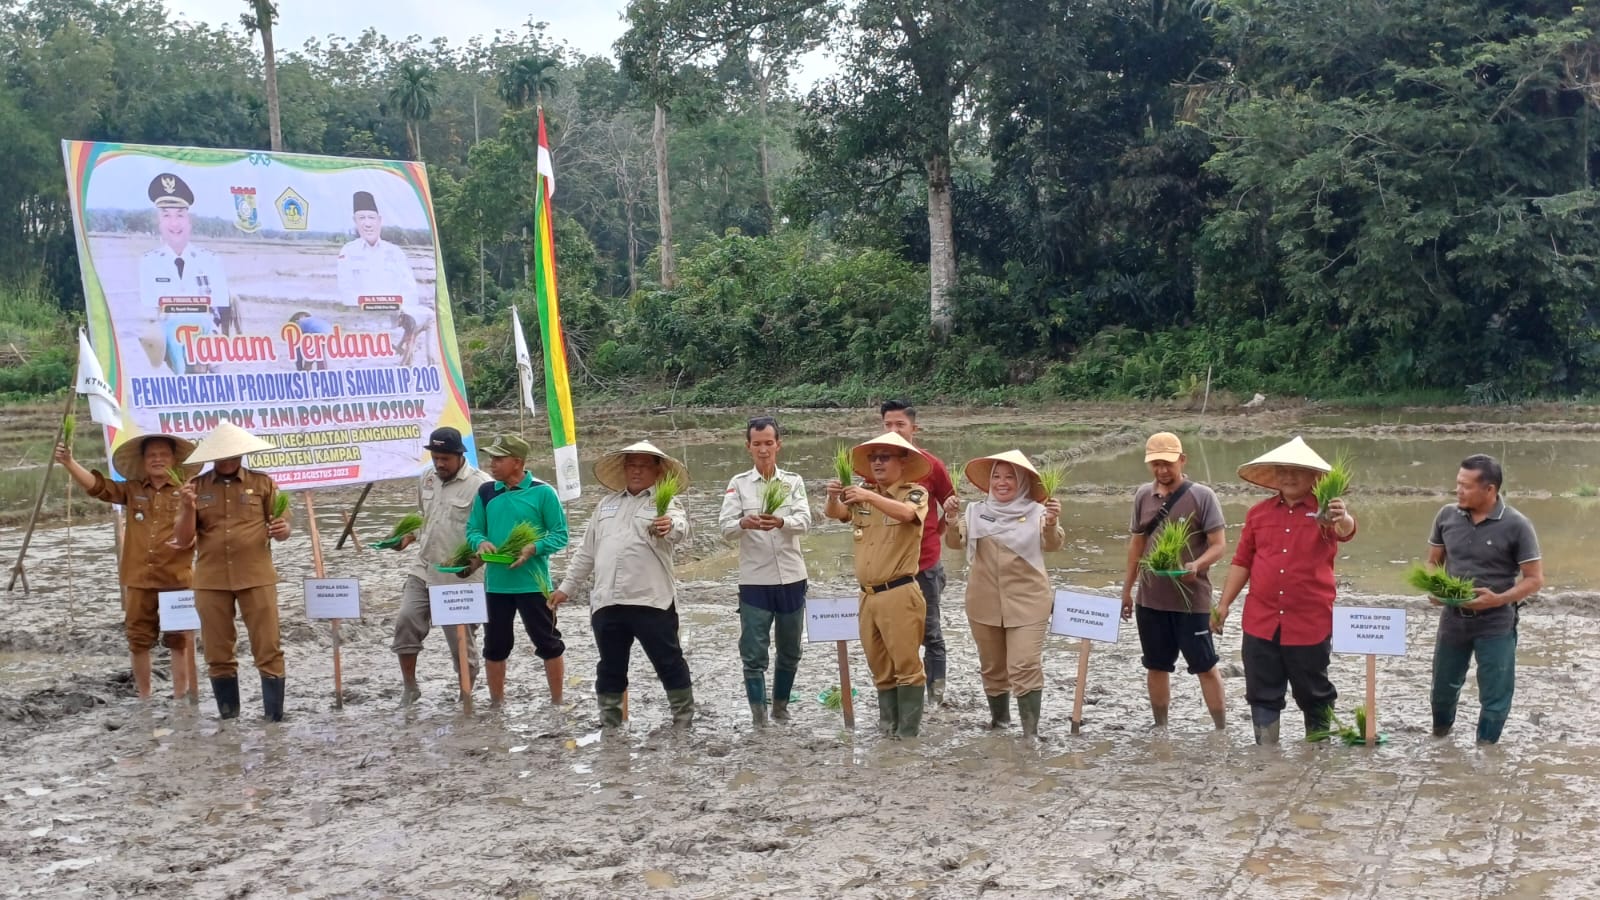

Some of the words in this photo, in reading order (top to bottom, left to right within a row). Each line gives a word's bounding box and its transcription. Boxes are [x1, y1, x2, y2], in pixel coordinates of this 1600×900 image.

[176, 325, 276, 363] Tanam
[281, 323, 394, 361] Perdana
[131, 374, 235, 406] PENINGKATAN
[237, 372, 309, 401] PRODUKSI
[310, 370, 345, 398] PADI
[345, 368, 396, 396] SAWAH
[397, 367, 411, 393] IP
[413, 366, 440, 392] 200
[258, 407, 296, 428] TANI
[298, 402, 366, 427] BONCAH
[367, 399, 426, 421] KOSIOK
[282, 428, 350, 448] KECAMATAN
[350, 424, 420, 443] BANGKINANG
[247, 449, 313, 468] KABUPATEN
[315, 445, 361, 464] KAMPAR
[301, 469, 332, 480] AGUSTUS
[1066, 607, 1090, 615] KEPALA
